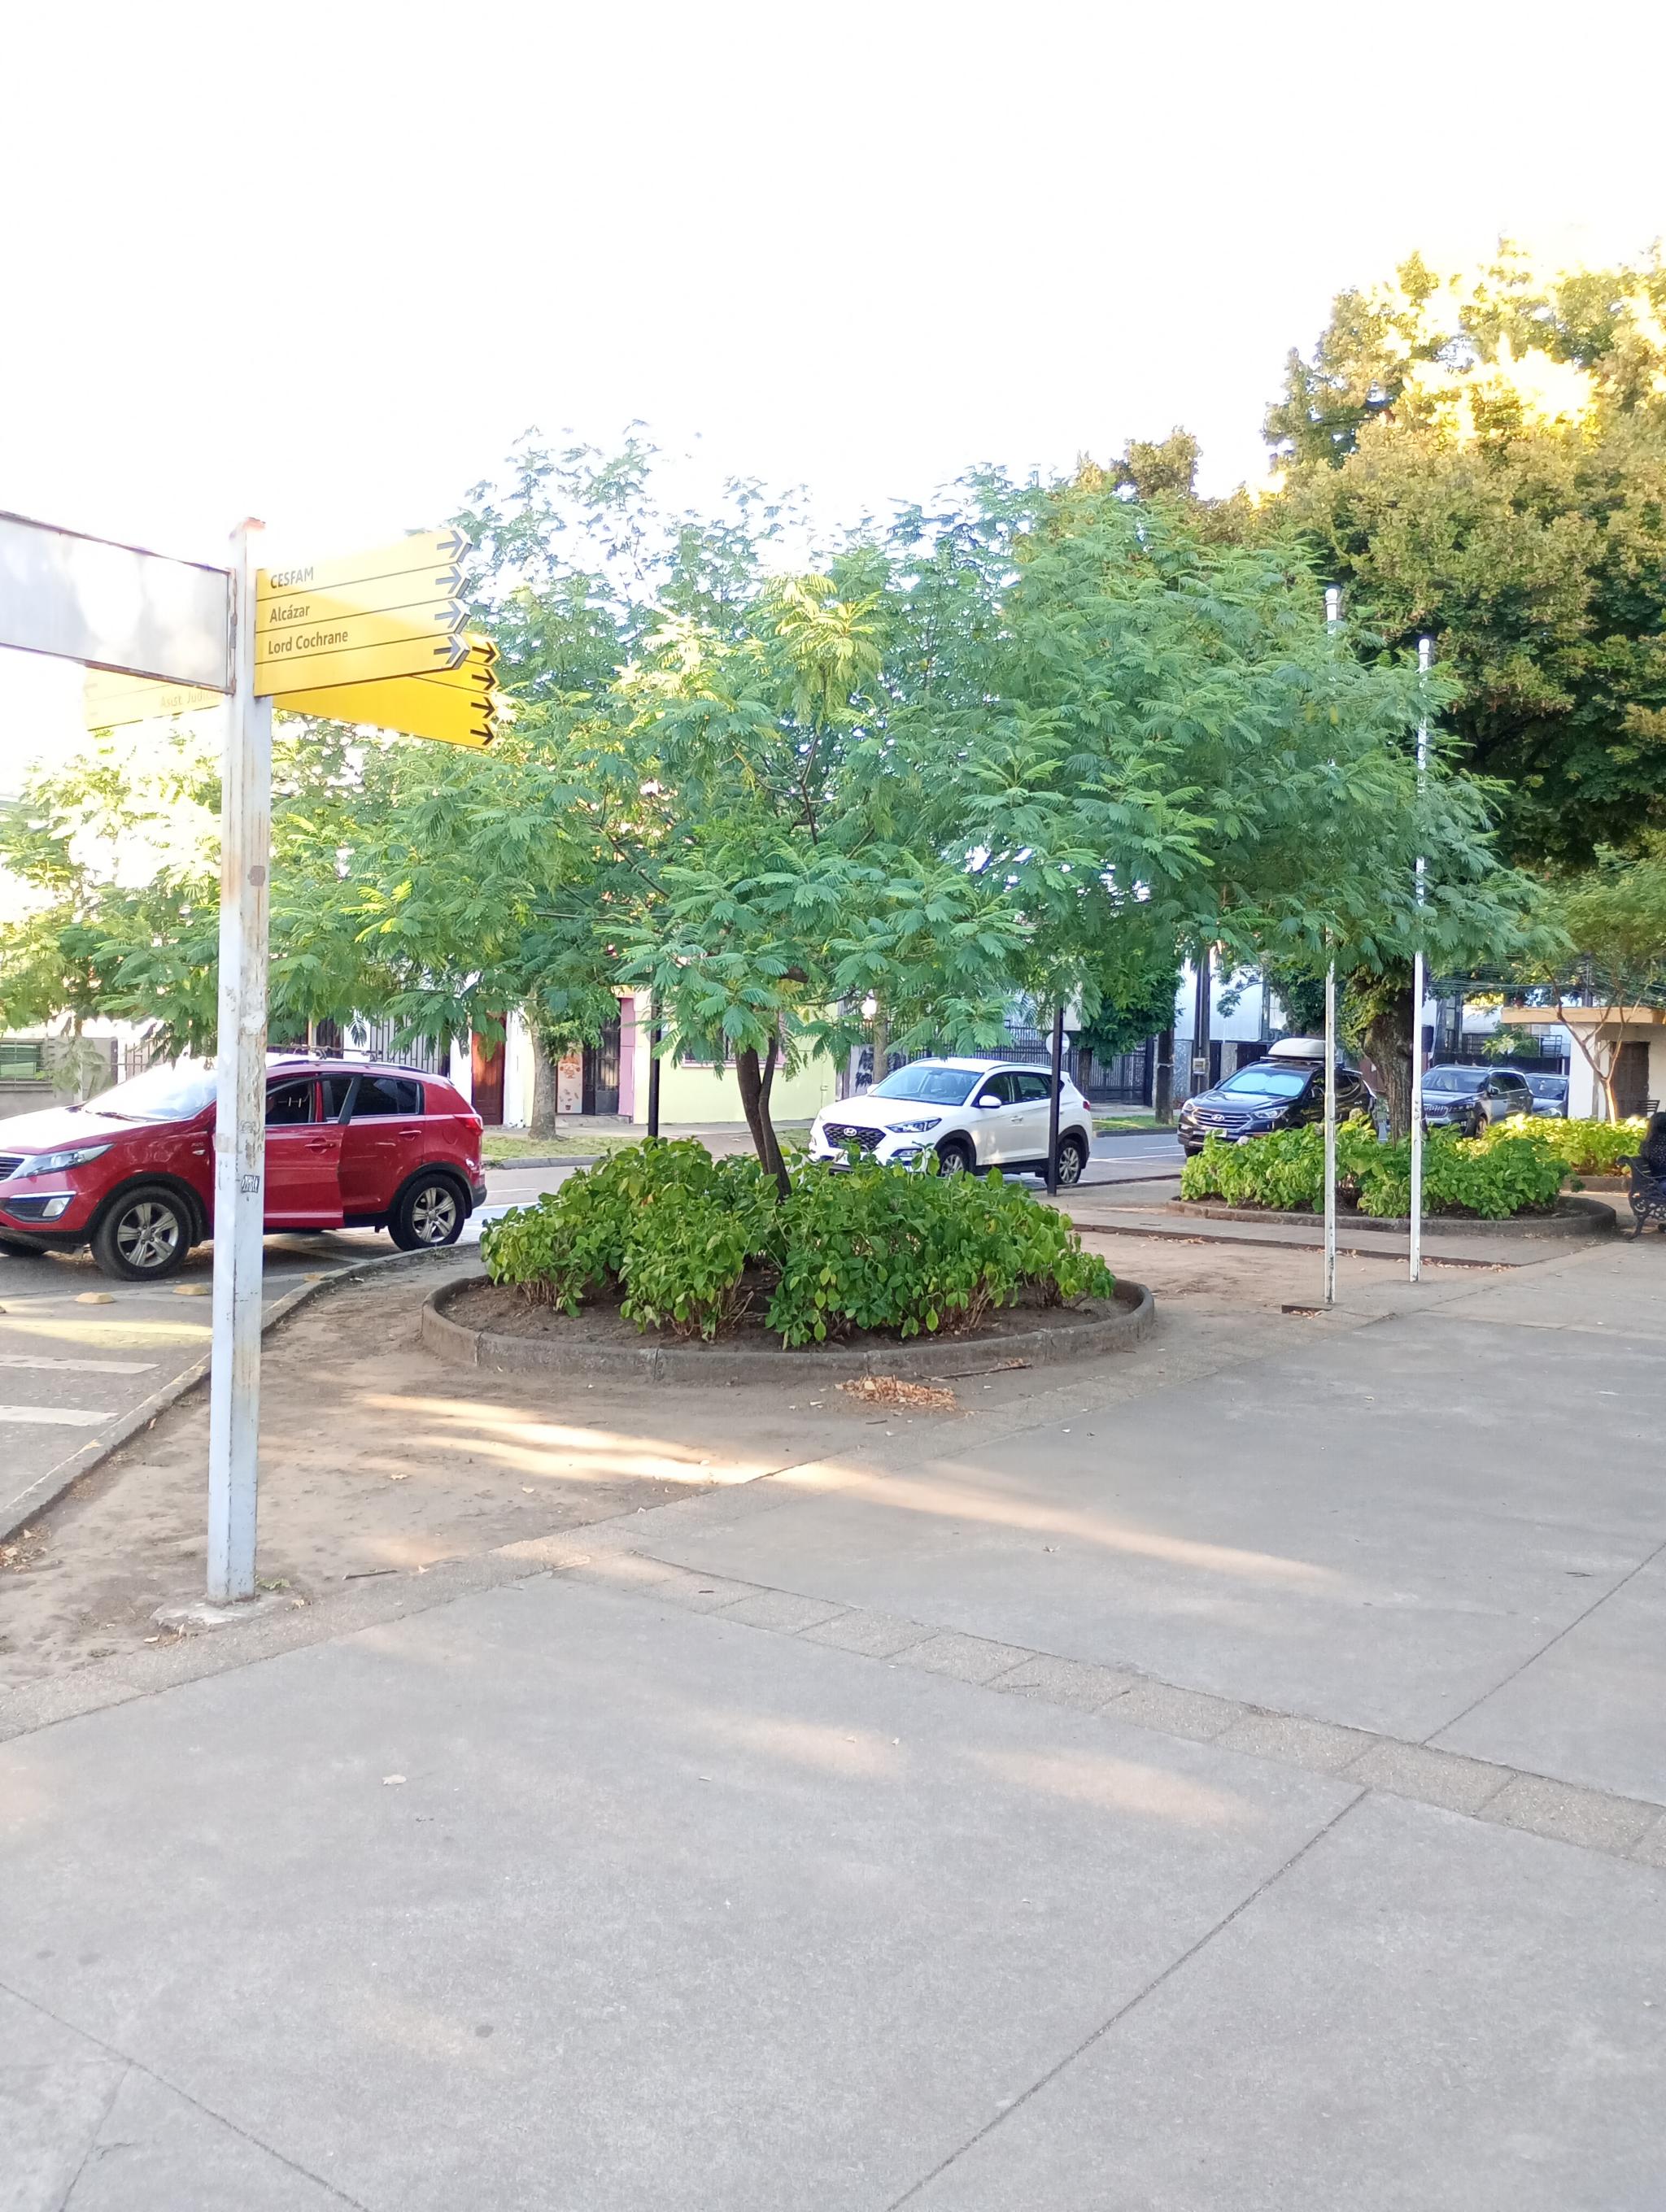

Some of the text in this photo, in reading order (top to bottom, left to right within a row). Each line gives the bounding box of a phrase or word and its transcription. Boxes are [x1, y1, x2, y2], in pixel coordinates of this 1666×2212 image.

[270, 567, 314, 589] CESFAM
[269, 604, 310, 623] Alcázar
[268, 632, 348, 655] Lord Cochrane
